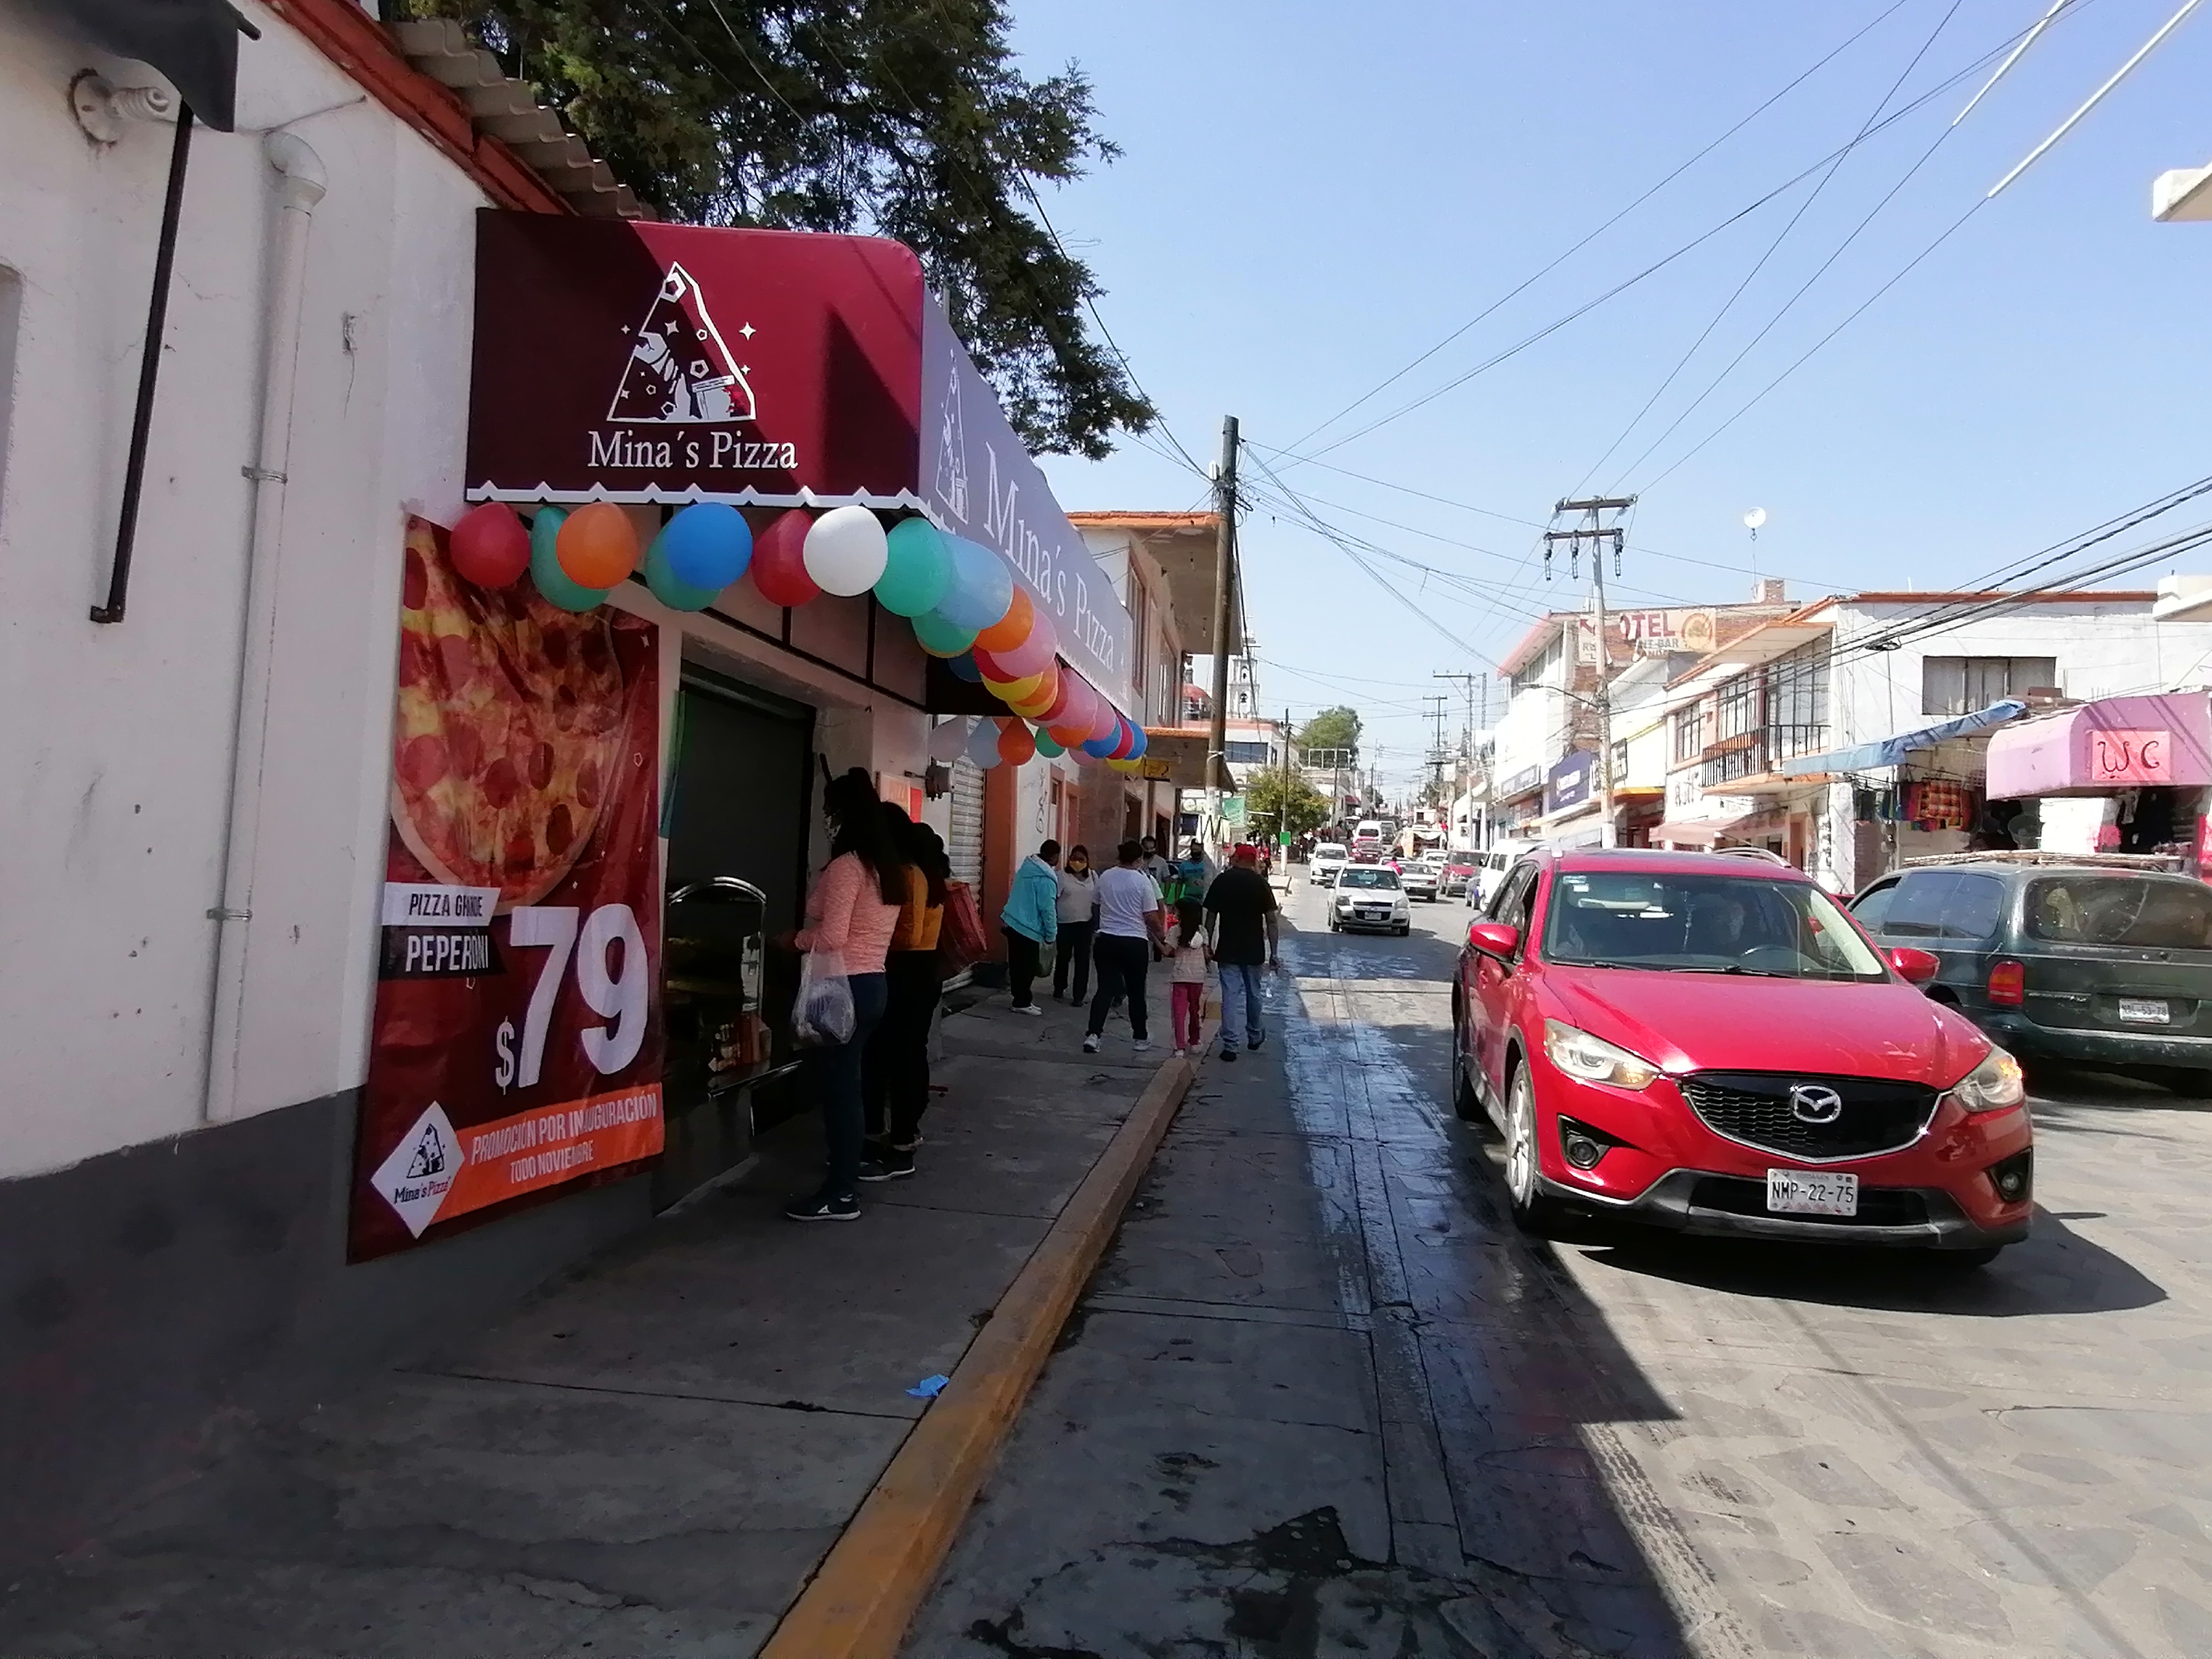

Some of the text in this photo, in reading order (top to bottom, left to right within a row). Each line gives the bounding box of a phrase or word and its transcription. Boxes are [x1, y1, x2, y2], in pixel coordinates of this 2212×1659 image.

[709, 431, 798, 470] Pizza
[1073, 573, 1114, 673] Pizza
[409, 893, 451, 916] PIZZA
[405, 935, 489, 972] PEPERONI
[470, 1115, 537, 1166] PROMOCIÓN
[539, 1113, 566, 1145] POR
[510, 1154, 536, 1184] TODO
[1771, 1181, 1854, 1203] NMP-22-75
